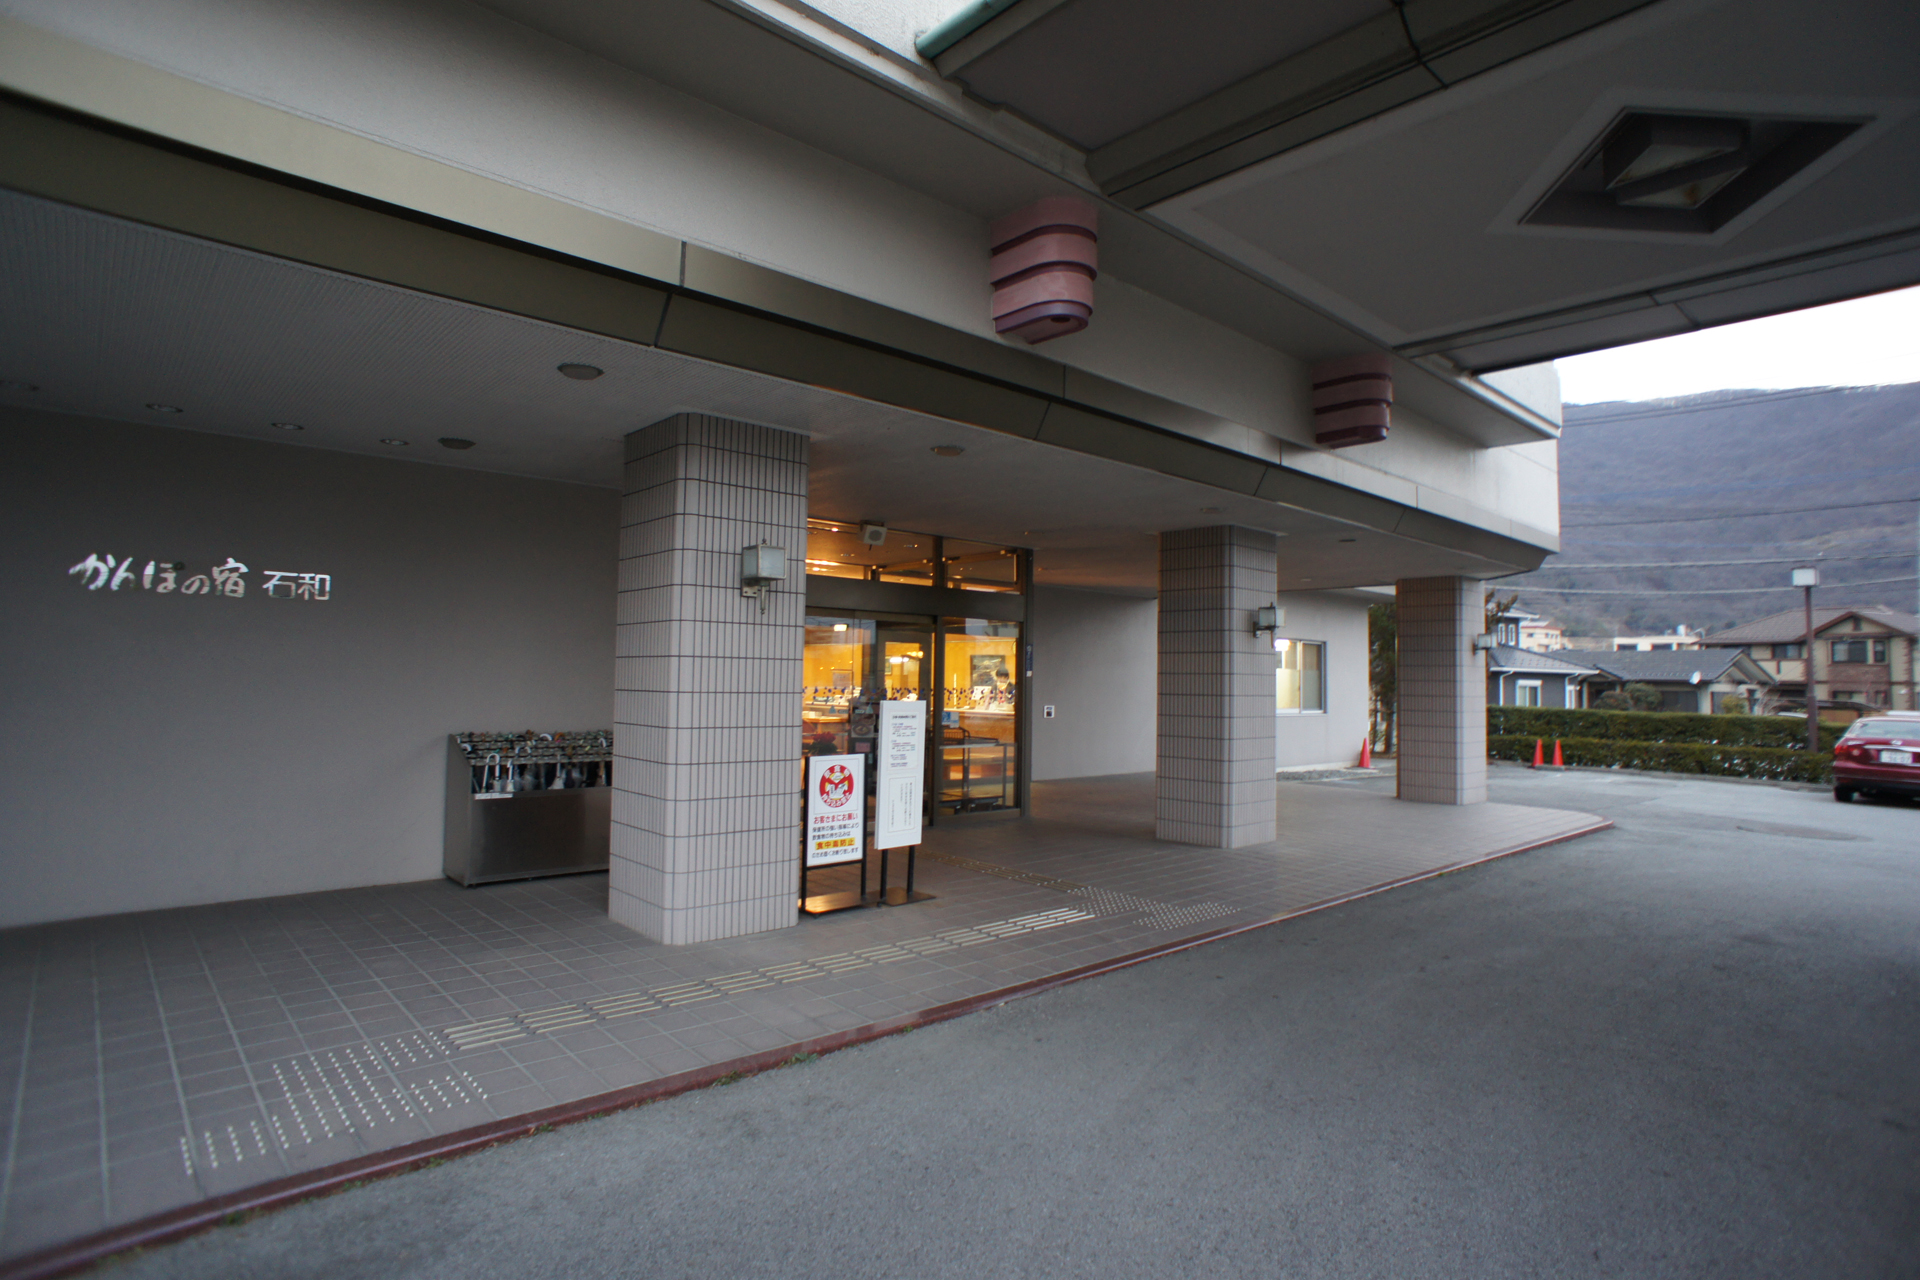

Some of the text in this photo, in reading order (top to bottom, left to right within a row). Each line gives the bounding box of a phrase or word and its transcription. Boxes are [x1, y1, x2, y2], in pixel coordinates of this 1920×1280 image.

[262, 570, 331, 601] 石和
[813, 813, 858, 824] お客さまにお願い
[816, 839, 855, 850] 食中毒防止
